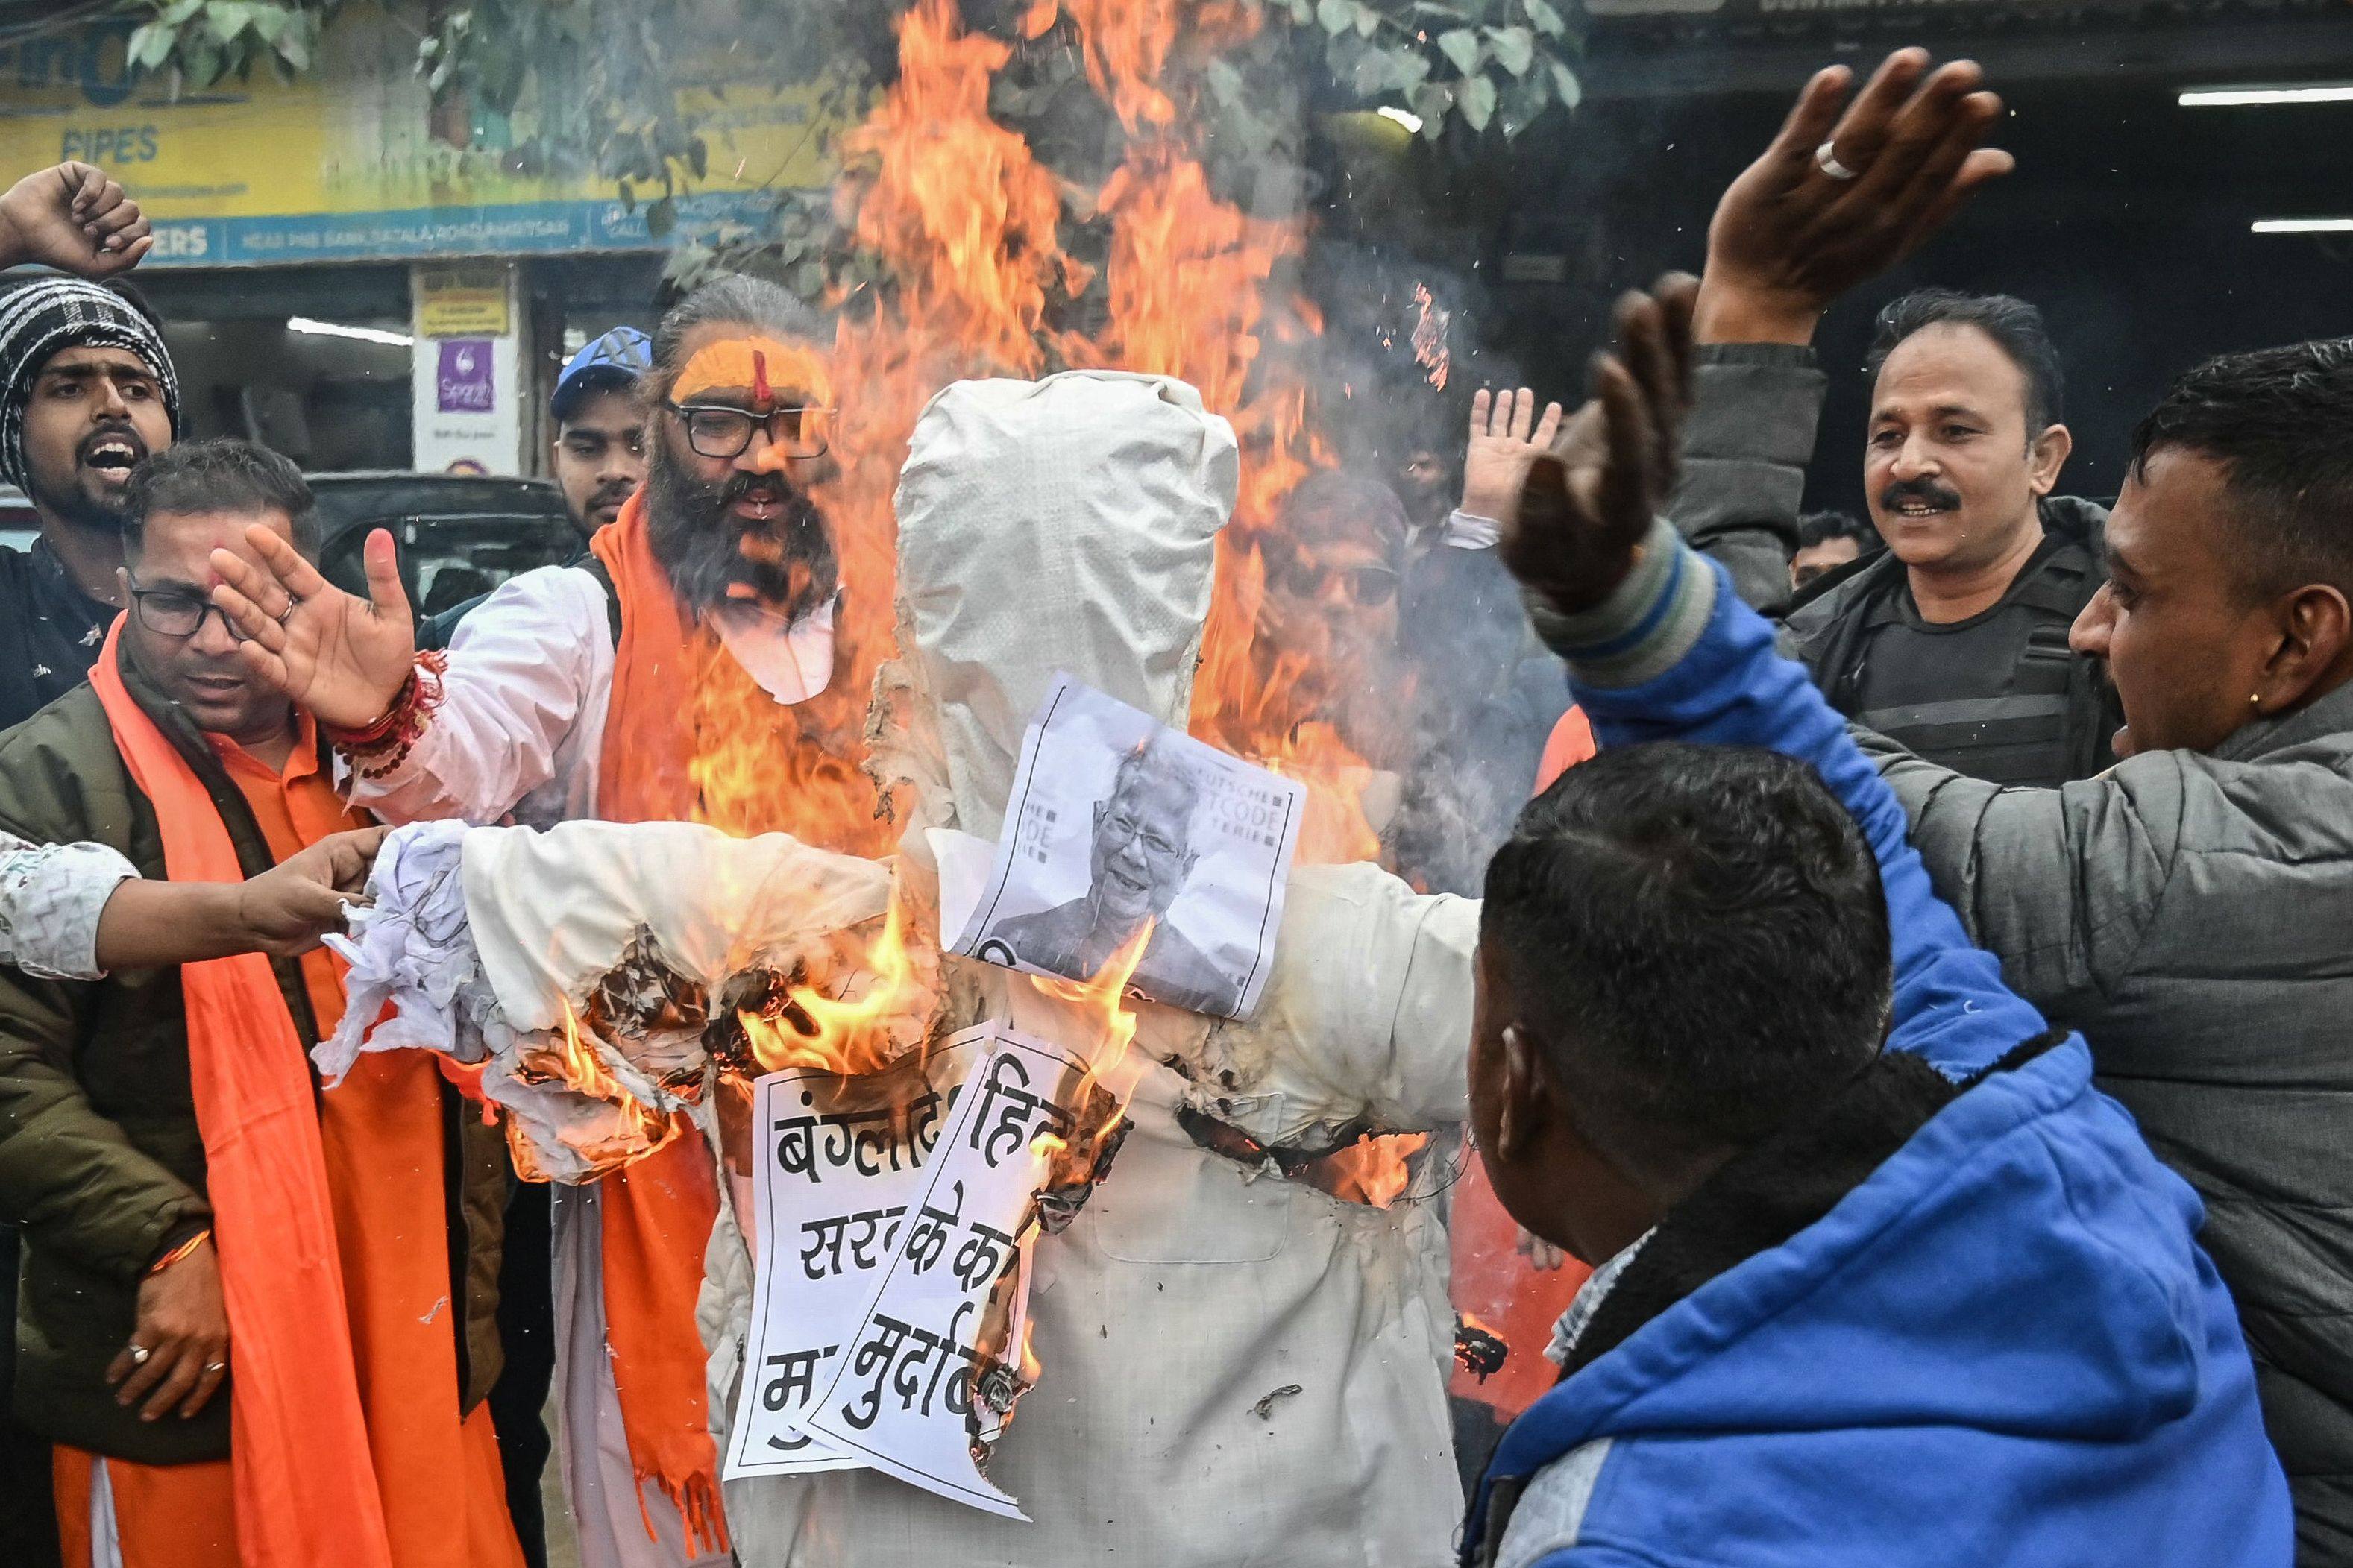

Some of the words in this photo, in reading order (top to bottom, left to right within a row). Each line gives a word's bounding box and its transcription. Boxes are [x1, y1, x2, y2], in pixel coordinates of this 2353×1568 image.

[62, 125, 160, 163] PIPES
[151, 226, 208, 257] ERS
[1207, 790, 1279, 831] TCODE
[906, 1179, 960, 1276] के
